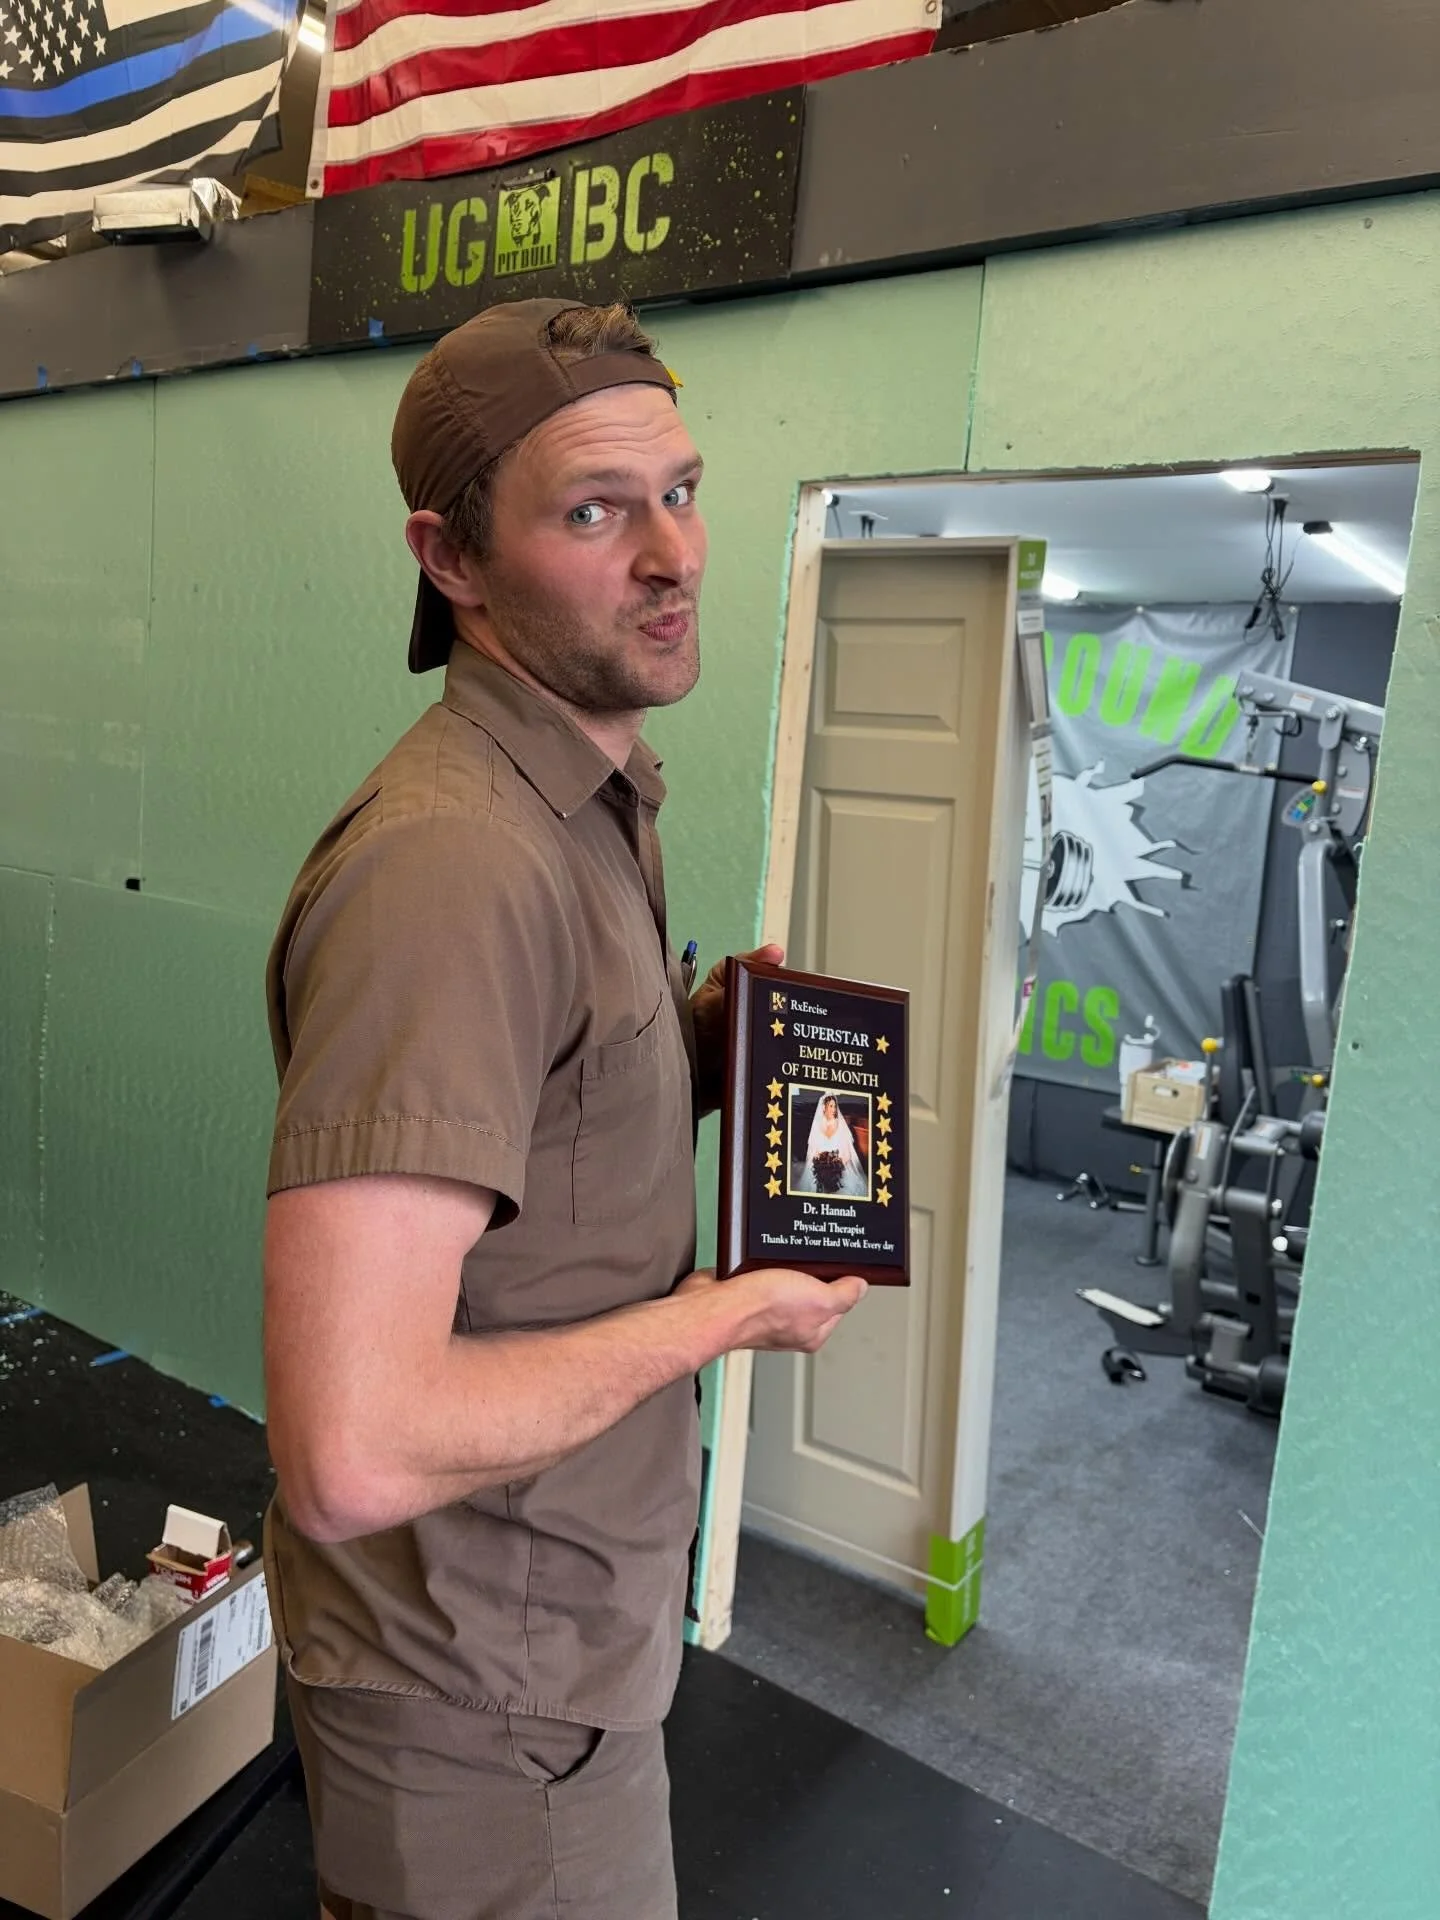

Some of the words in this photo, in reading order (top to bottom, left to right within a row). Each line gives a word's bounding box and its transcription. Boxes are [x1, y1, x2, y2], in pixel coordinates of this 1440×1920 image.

[401, 197, 488, 292] UG
[571, 153, 674, 264] BC
[1044, 631, 1240, 760] OUND
[790, 999, 828, 1016] RxErcise
[793, 1022, 869, 1047] SUPERSTAR
[799, 1044, 863, 1067] EMPLOYEE
[781, 1061, 800, 1077] OF
[802, 1064, 829, 1081] THE
[831, 1069, 879, 1088] MONTH
[803, 1202, 818, 1215] Dr.
[820, 1203, 856, 1217] Hannah
[793, 1220, 826, 1233] Physical
[827, 1222, 865, 1236] Therapist
[761, 1233, 789, 1245] Thanks
[789, 1235, 803, 1246] For
[803, 1236, 822, 1247] Your
[822, 1237, 841, 1248] Hard
[841, 1238, 862, 1249] Work
[862, 1240, 882, 1251] Every
[883, 1241, 895, 1252] day
